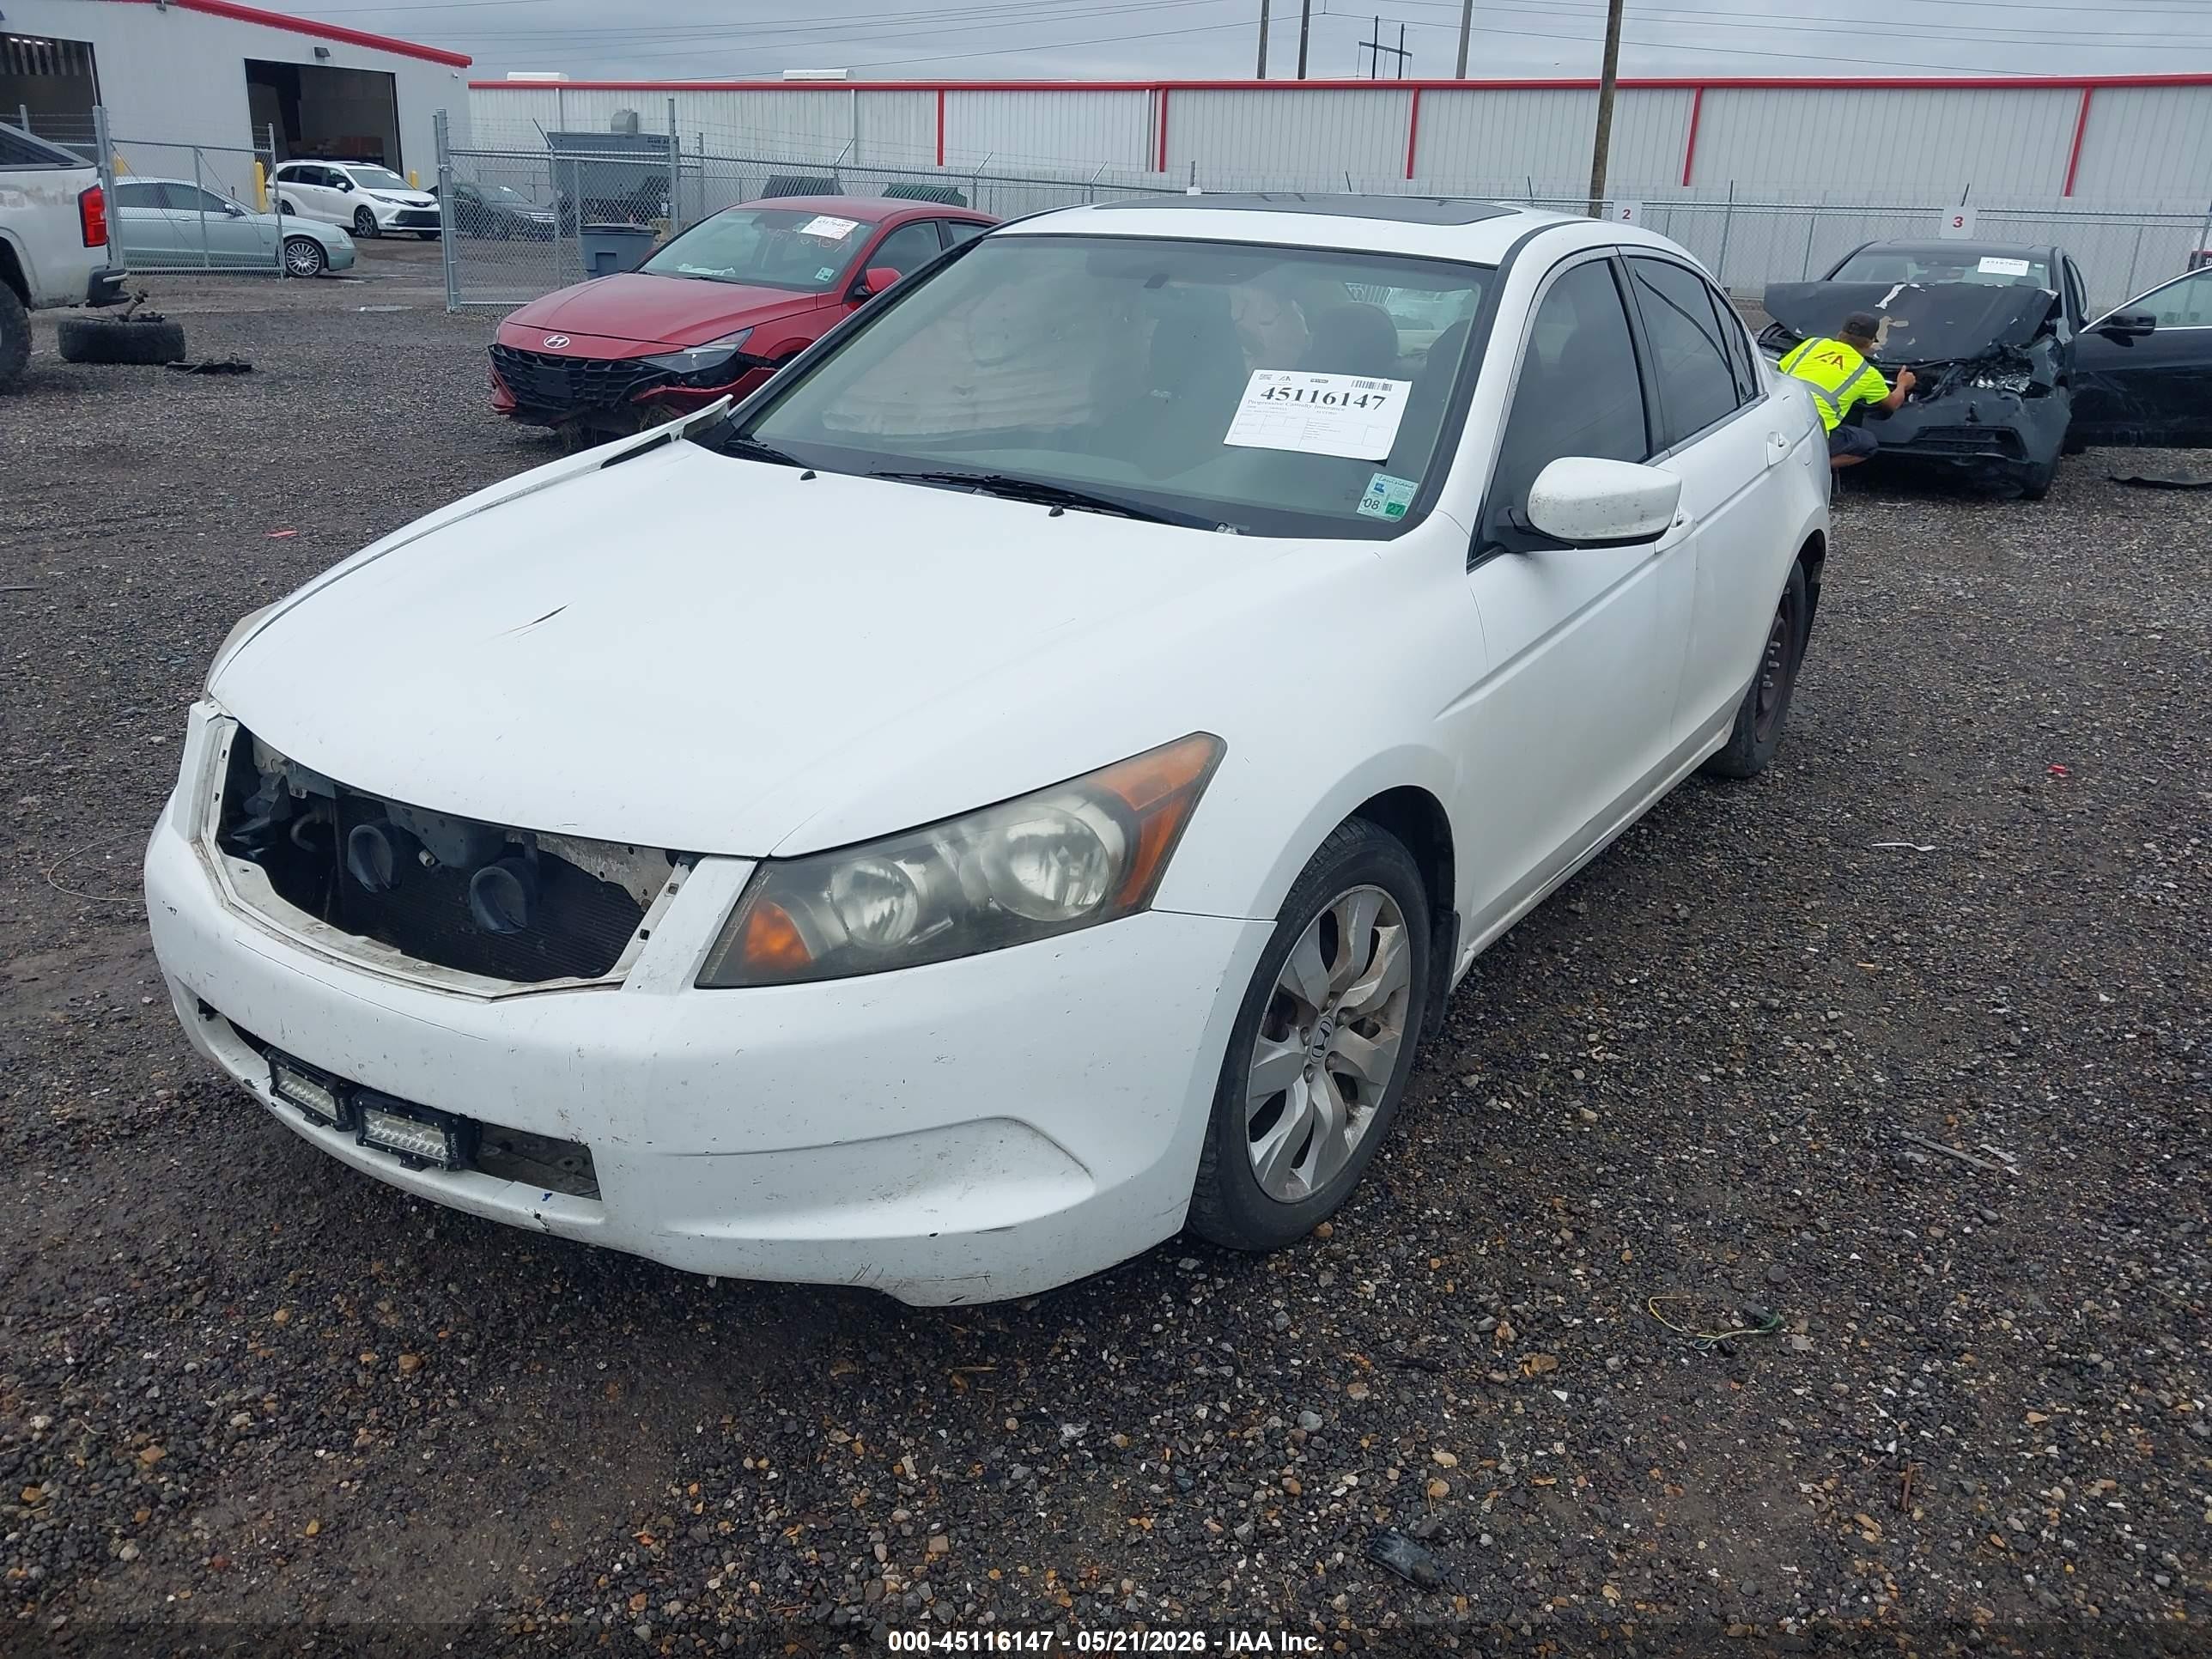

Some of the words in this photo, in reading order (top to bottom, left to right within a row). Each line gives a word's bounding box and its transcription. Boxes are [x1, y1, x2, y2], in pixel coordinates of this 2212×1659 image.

[1622, 209, 1632, 220] 2
[1953, 216, 1964, 228] 3
[1260, 386, 1387, 410] 45116147
[1315, 404, 1346, 412] Insurance
[1364, 498, 1381, 510] 08
[1389, 503, 1405, 515] 27
